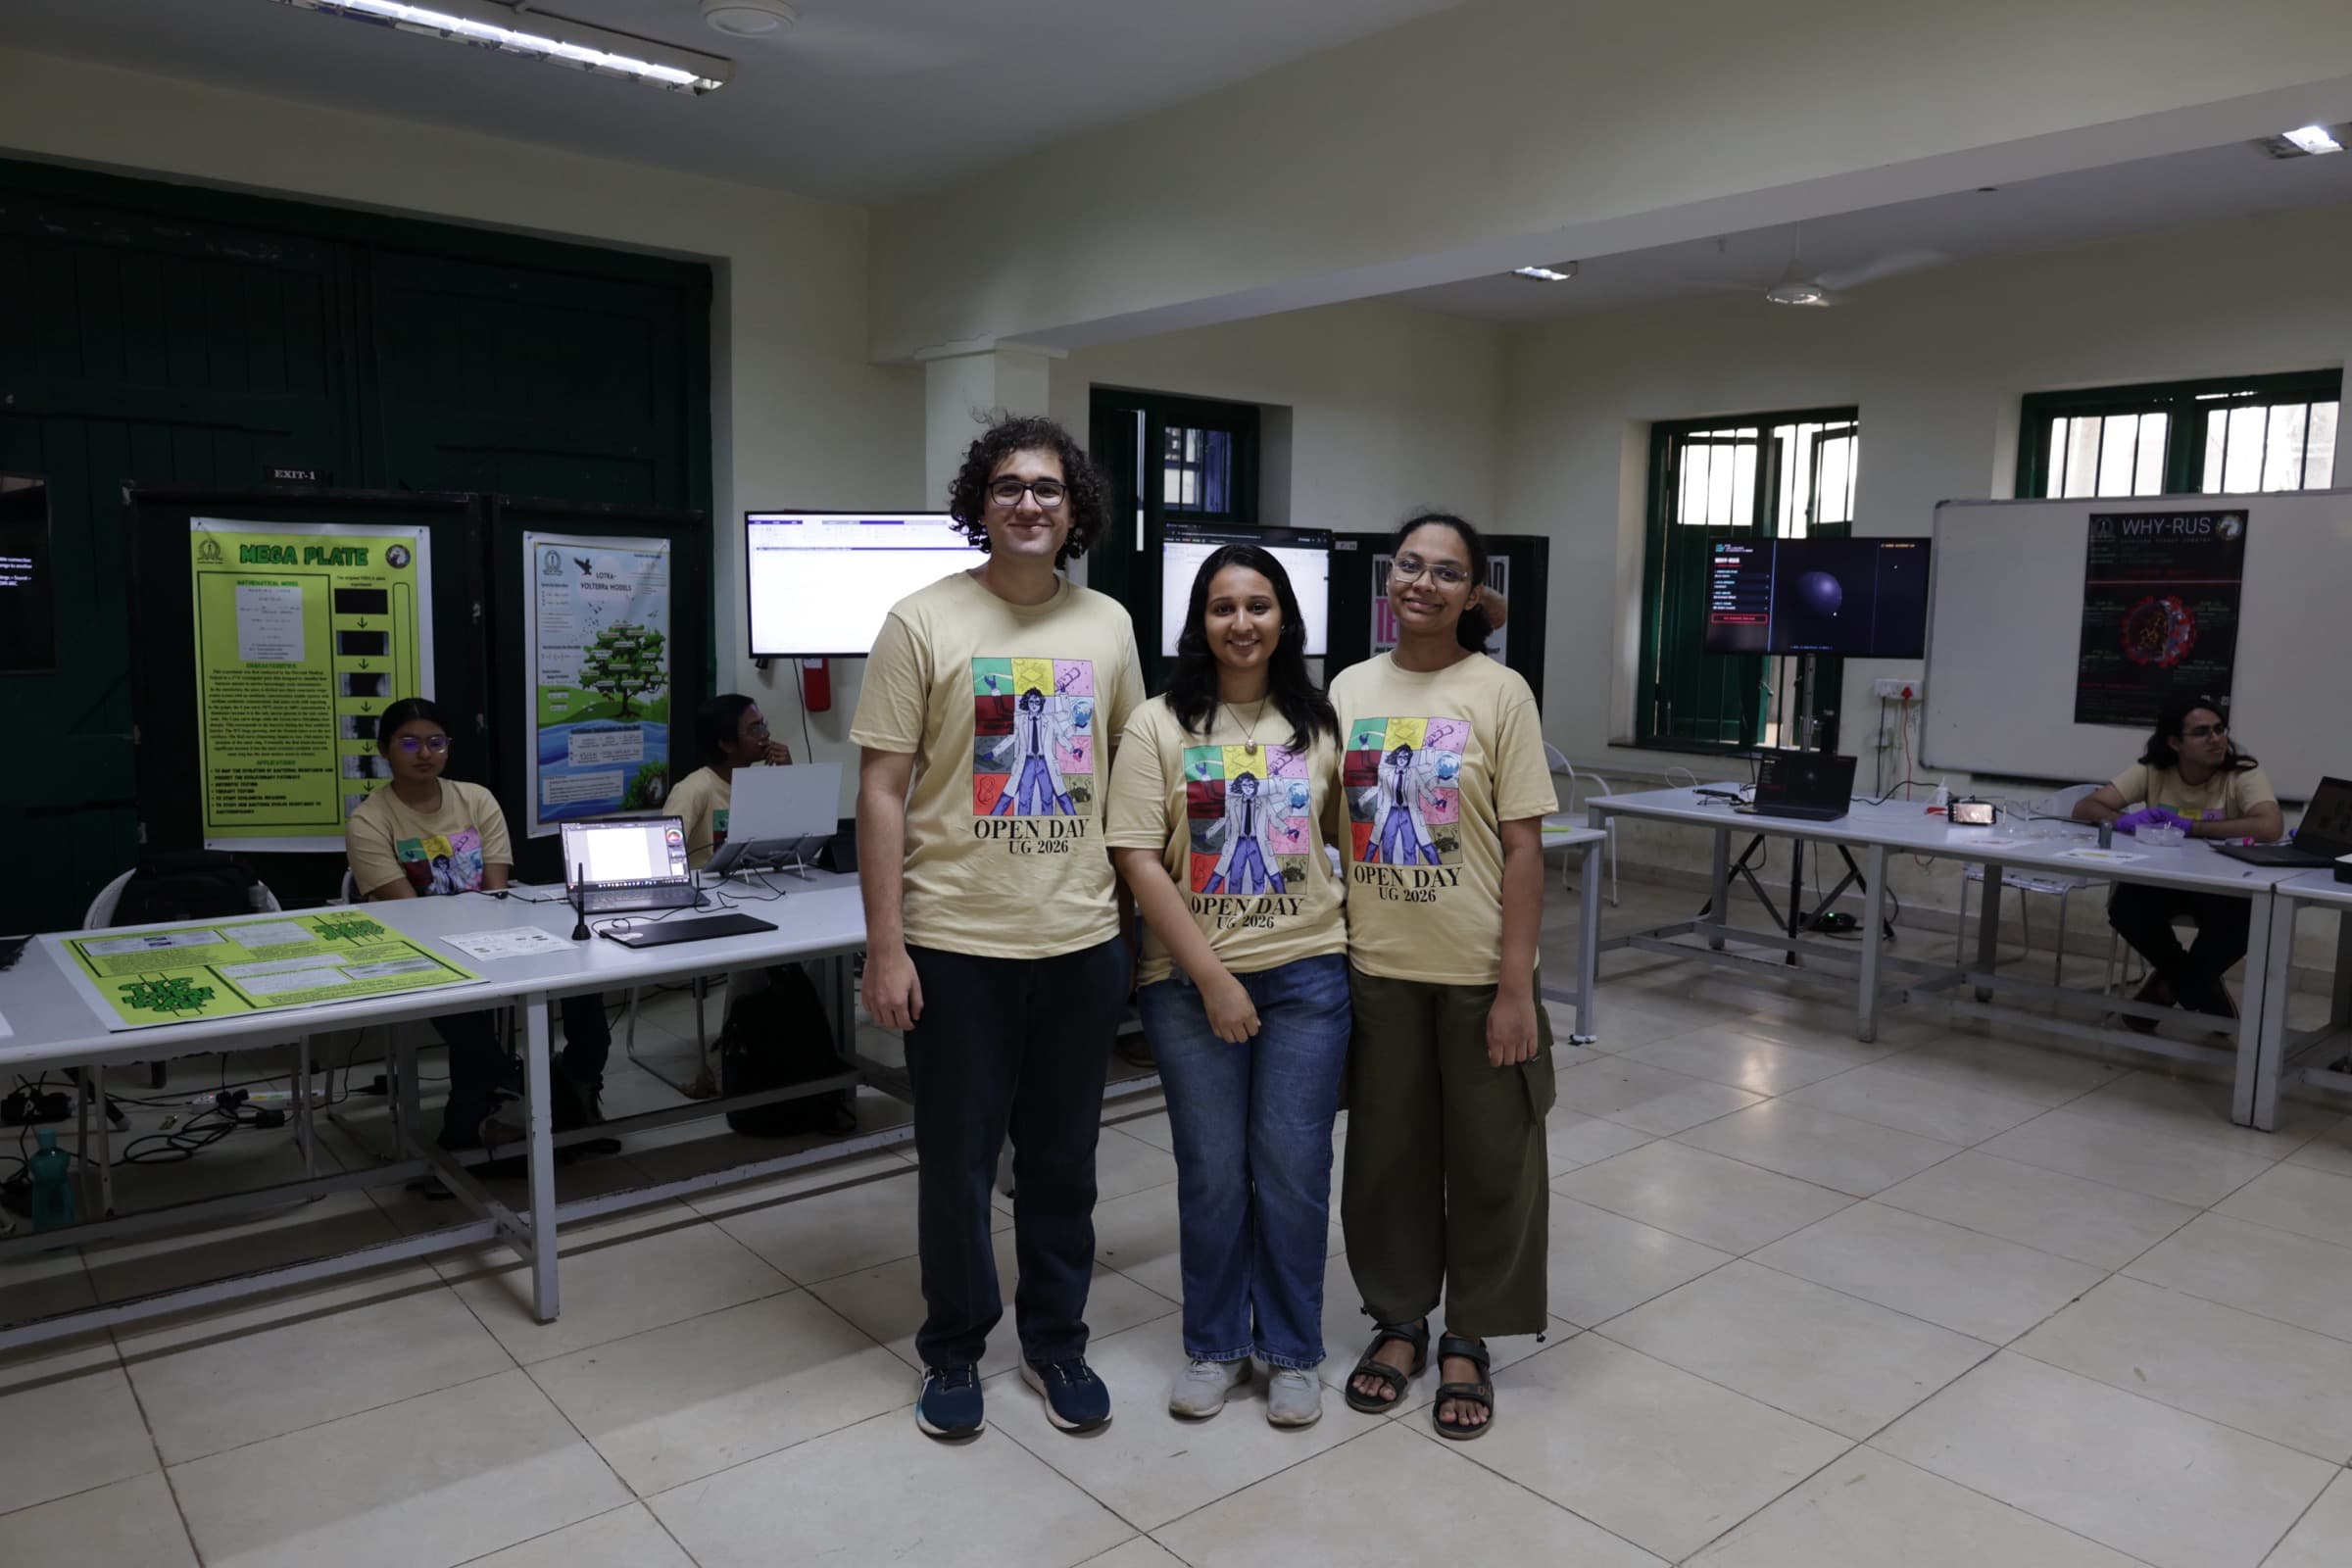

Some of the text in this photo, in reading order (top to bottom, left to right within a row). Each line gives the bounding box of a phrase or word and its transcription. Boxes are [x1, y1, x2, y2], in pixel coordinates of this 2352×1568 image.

[273, 468, 317, 480] EXIT-1
[2122, 516, 2212, 536] WHY-RUS
[239, 544, 368, 566] MEGA PLATE
[580, 582, 609, 591] VOLTERRA
[974, 818, 1091, 840] OPEN DAY
[1008, 840, 1069, 855] UG 2026
[1354, 864, 1463, 889] OPEN DAY
[1379, 887, 1437, 903] UG 2026
[1191, 897, 1303, 916] OPEN DAY
[1216, 915, 1275, 930] UG 2026
